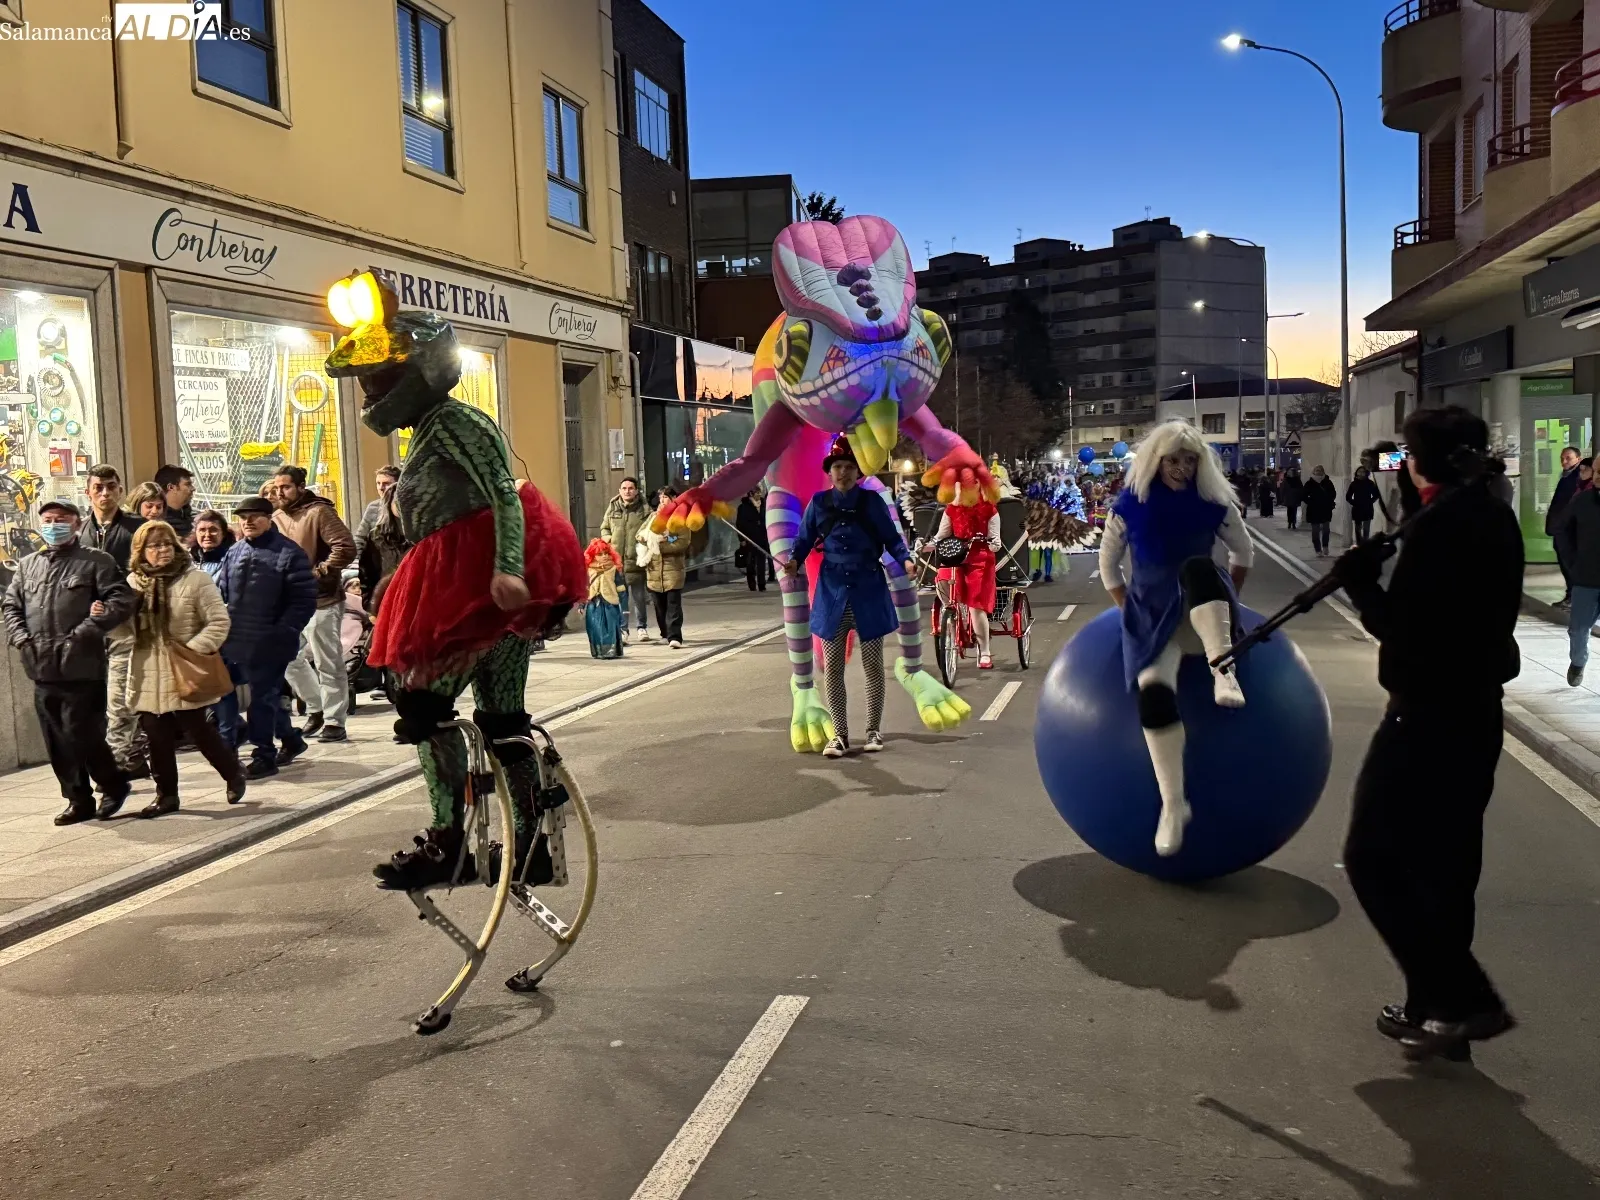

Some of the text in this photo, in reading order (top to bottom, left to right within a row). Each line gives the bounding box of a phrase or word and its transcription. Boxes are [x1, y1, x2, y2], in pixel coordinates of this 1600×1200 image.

[185, 349, 209, 365] FINCAS
[210, 351, 215, 365] Y
[177, 379, 219, 391] CERCADOS
